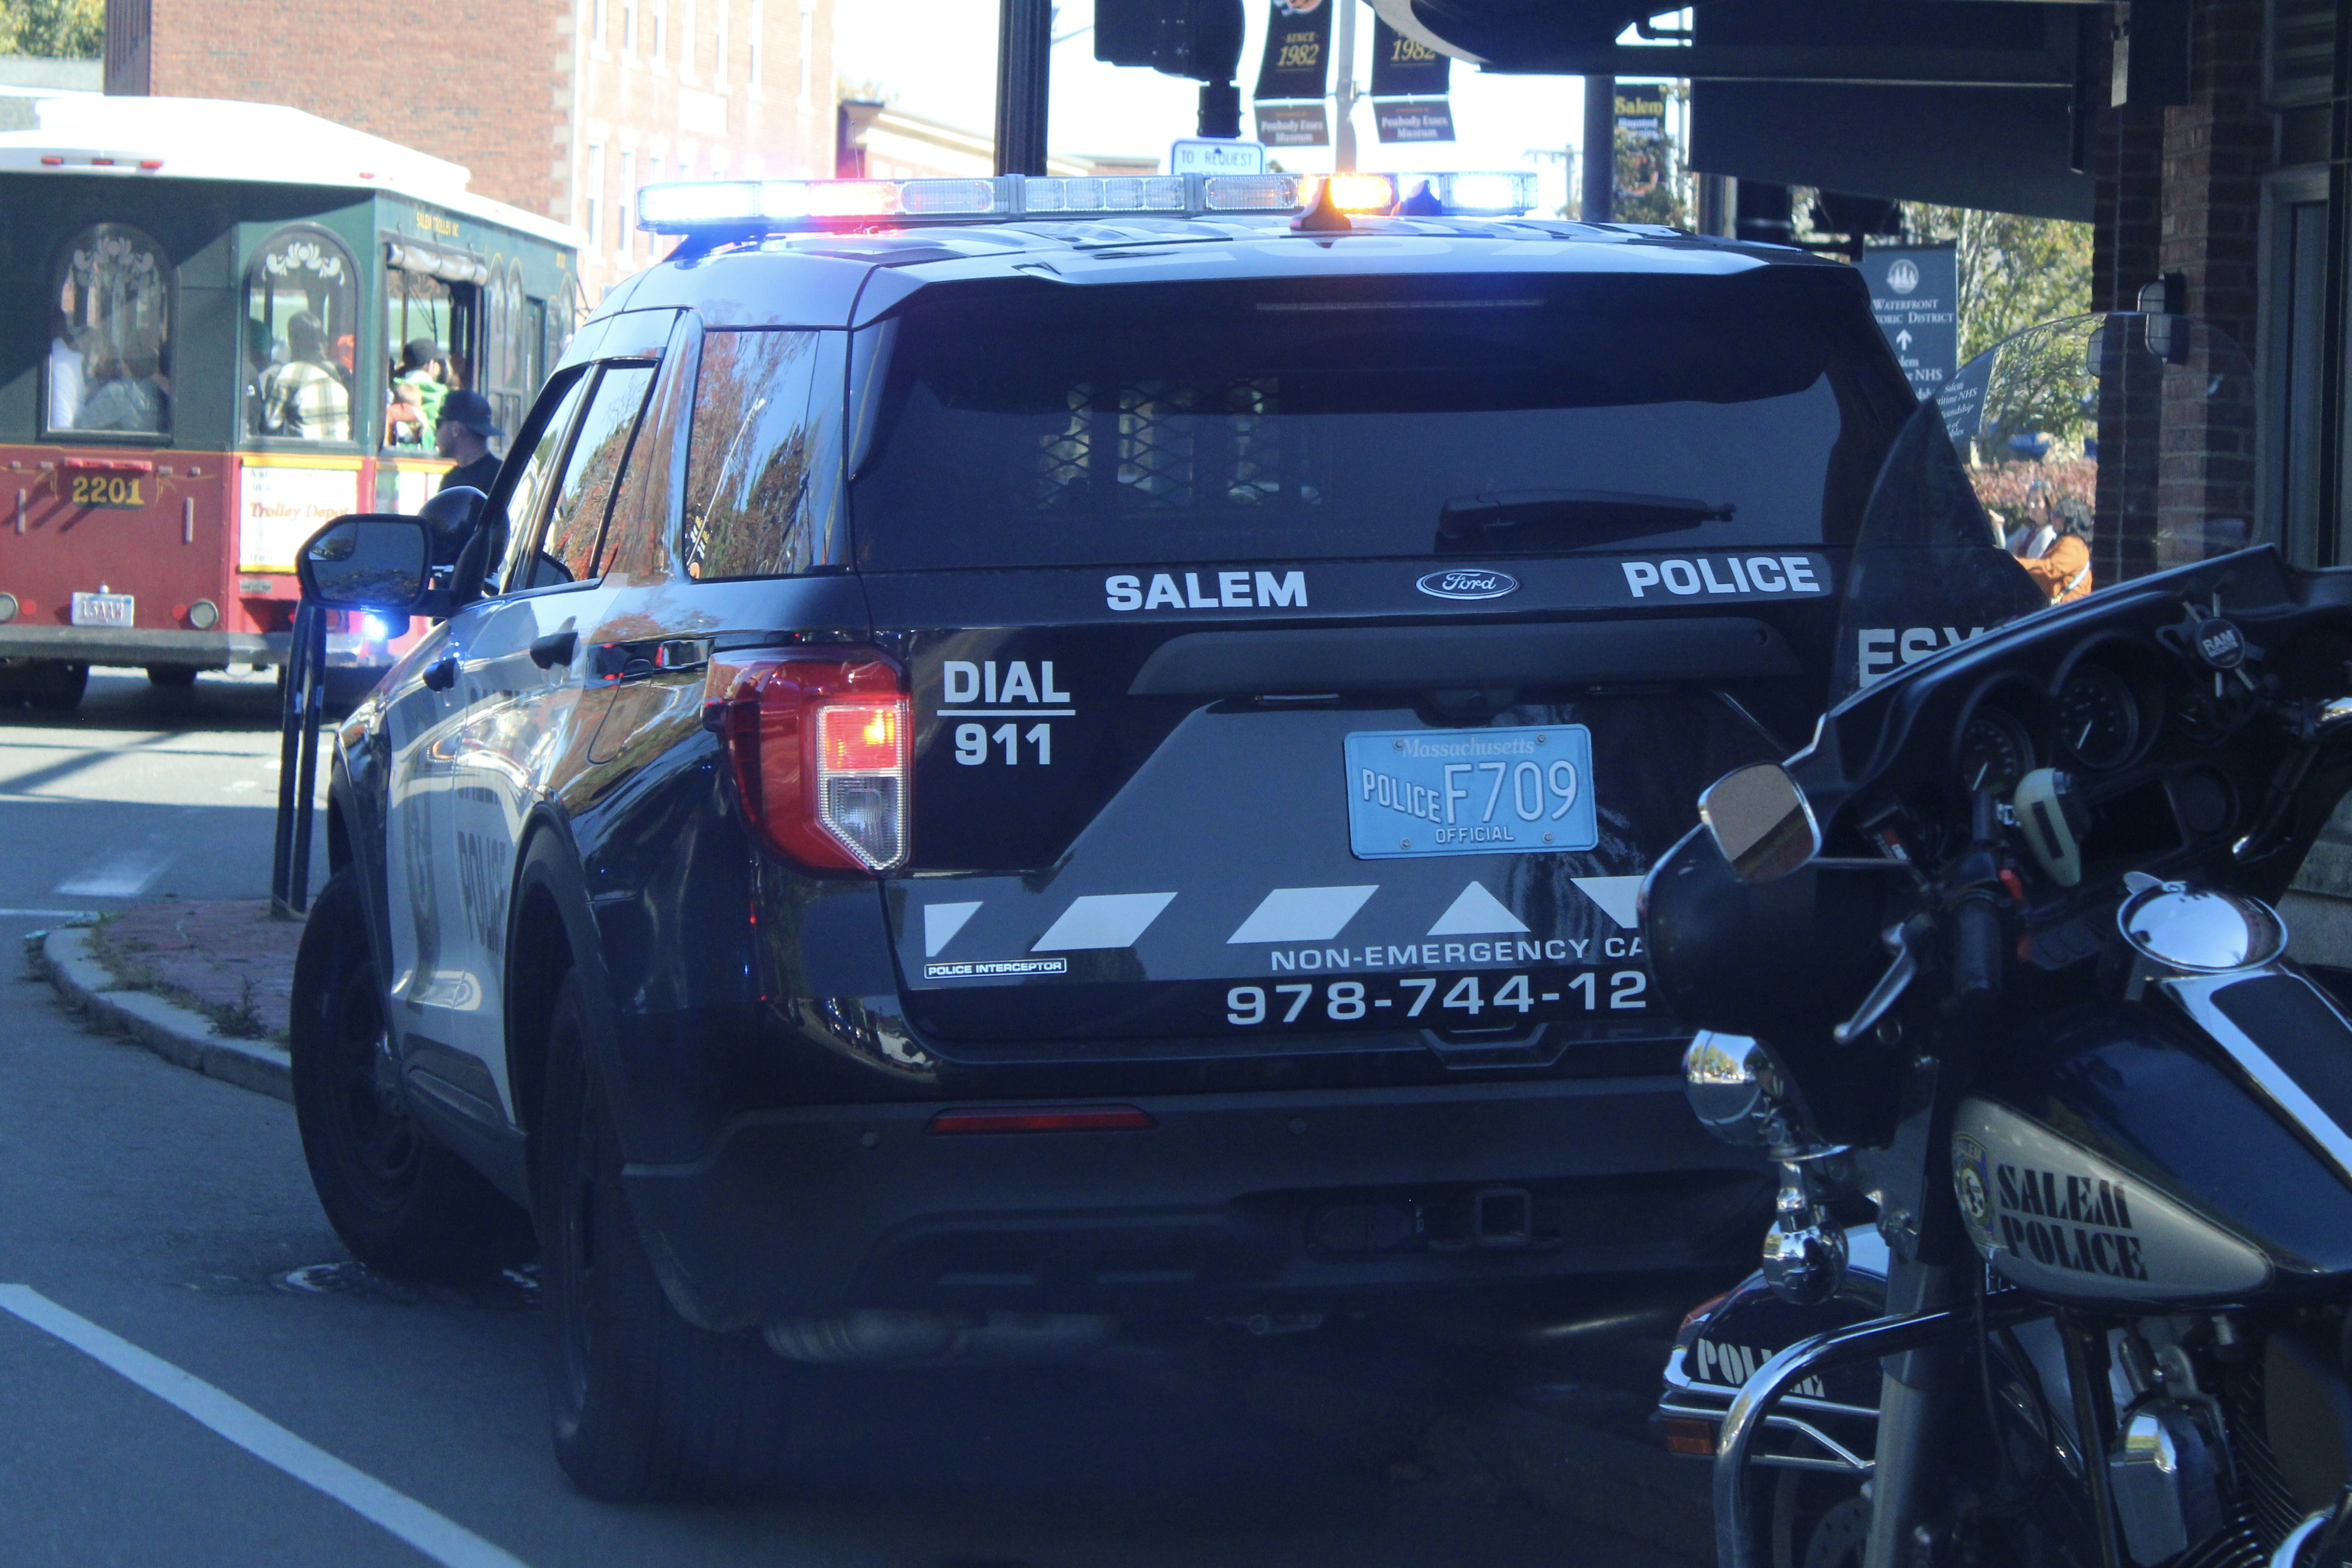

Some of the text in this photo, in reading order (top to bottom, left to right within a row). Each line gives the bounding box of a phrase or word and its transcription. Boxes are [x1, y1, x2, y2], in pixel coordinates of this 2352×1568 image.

[1277, 44, 1320, 66] 1982
[1614, 96, 1664, 116] Salem
[1181, 150, 1252, 166] TO REQUEST
[1908, 311, 1954, 325] DISTRICT
[1915, 369, 1943, 381] NHS
[1958, 387, 1978, 401] NHS
[72, 475, 145, 504] 2201
[249, 502, 350, 522] Trolley Depot
[1442, 572, 1497, 591] Ford
[1621, 557, 1820, 597] POLICE
[1105, 570, 1308, 612] SALEM
[2202, 630, 2236, 653] RAM
[944, 660, 1071, 704] DIAL
[955, 723, 1051, 765] 911
[1402, 737, 1535, 758] Massachusetts
[1362, 760, 1577, 825] POLICE F709
[1435, 826, 1515, 844] OFFICIAL
[1271, 937, 1643, 971] NON-EMERGENCY CA
[928, 962, 1062, 976] POLICE INTERCEPTOR
[1226, 971, 1646, 1025] 978-744-12
[1997, 1164, 2132, 1229] SALEM
[1999, 1213, 2149, 1281] POLICE
